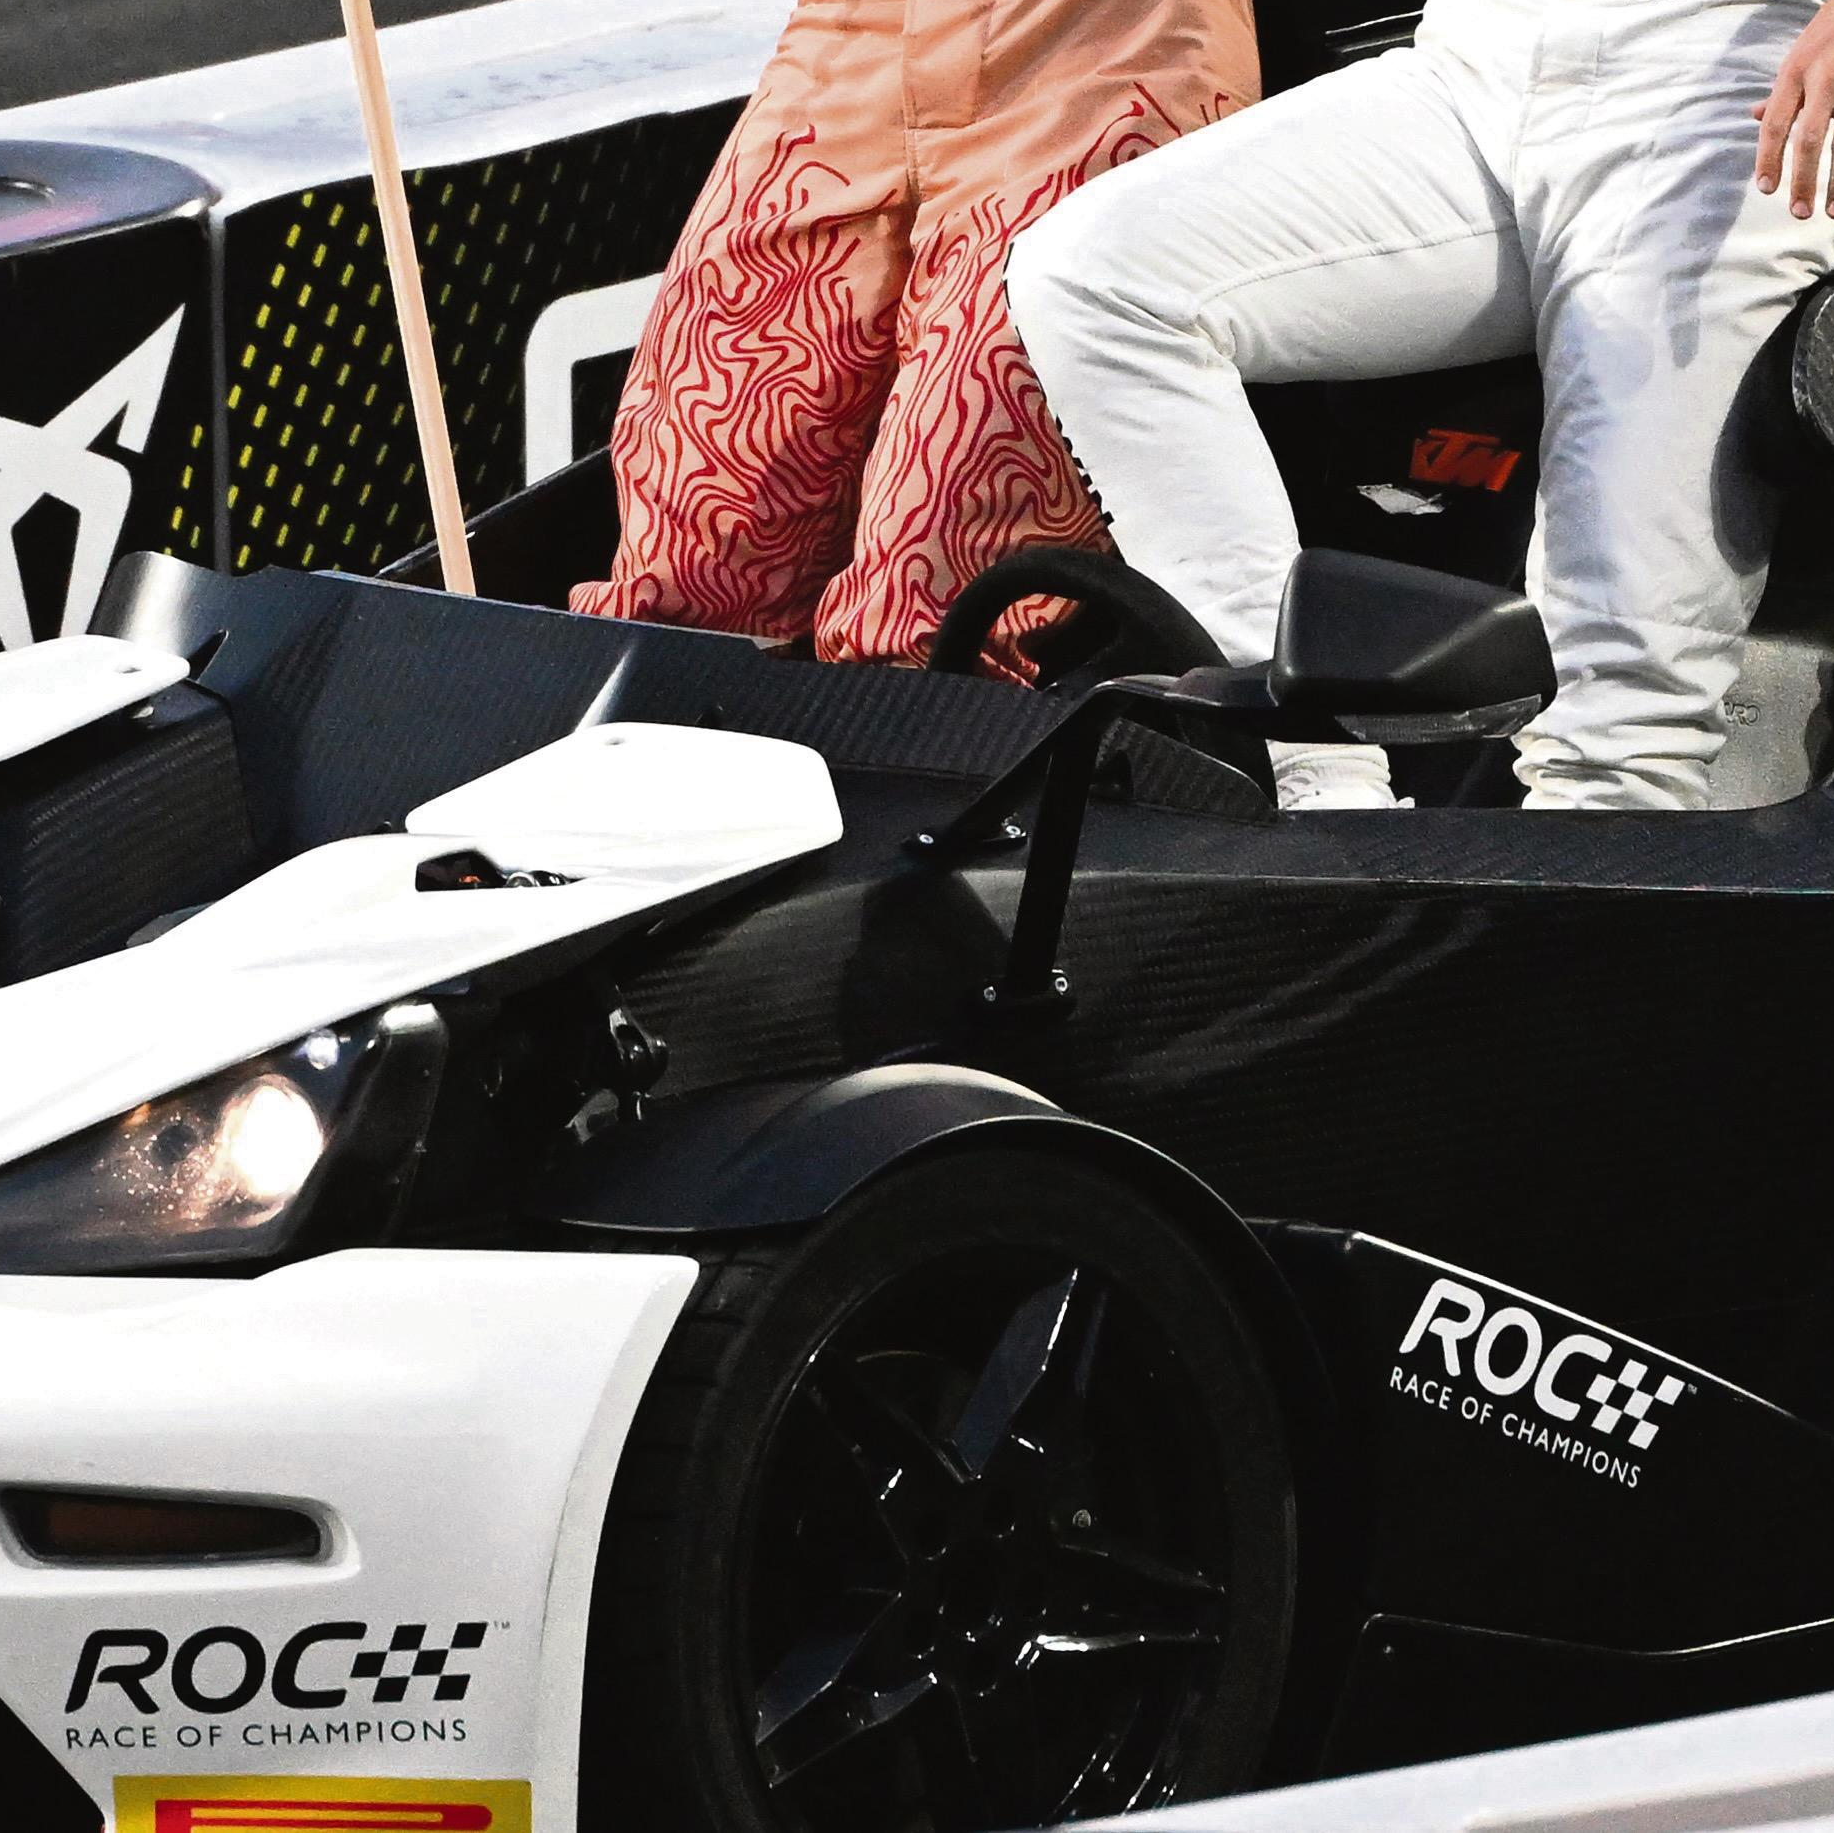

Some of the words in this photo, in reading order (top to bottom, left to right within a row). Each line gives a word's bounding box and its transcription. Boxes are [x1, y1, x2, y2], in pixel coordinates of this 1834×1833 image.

[1399, 1278, 1612, 1421] ROC
[1390, 1366, 1452, 1410] RACE
[1461, 1396, 1494, 1424] OF
[1501, 1412, 1642, 1489] CHAMPIONS
[65, 1622, 367, 1714] ROC
[66, 1725, 158, 1750] RACE
[176, 1723, 224, 1748] OF
[242, 1717, 468, 1747] CHAMPIONS
